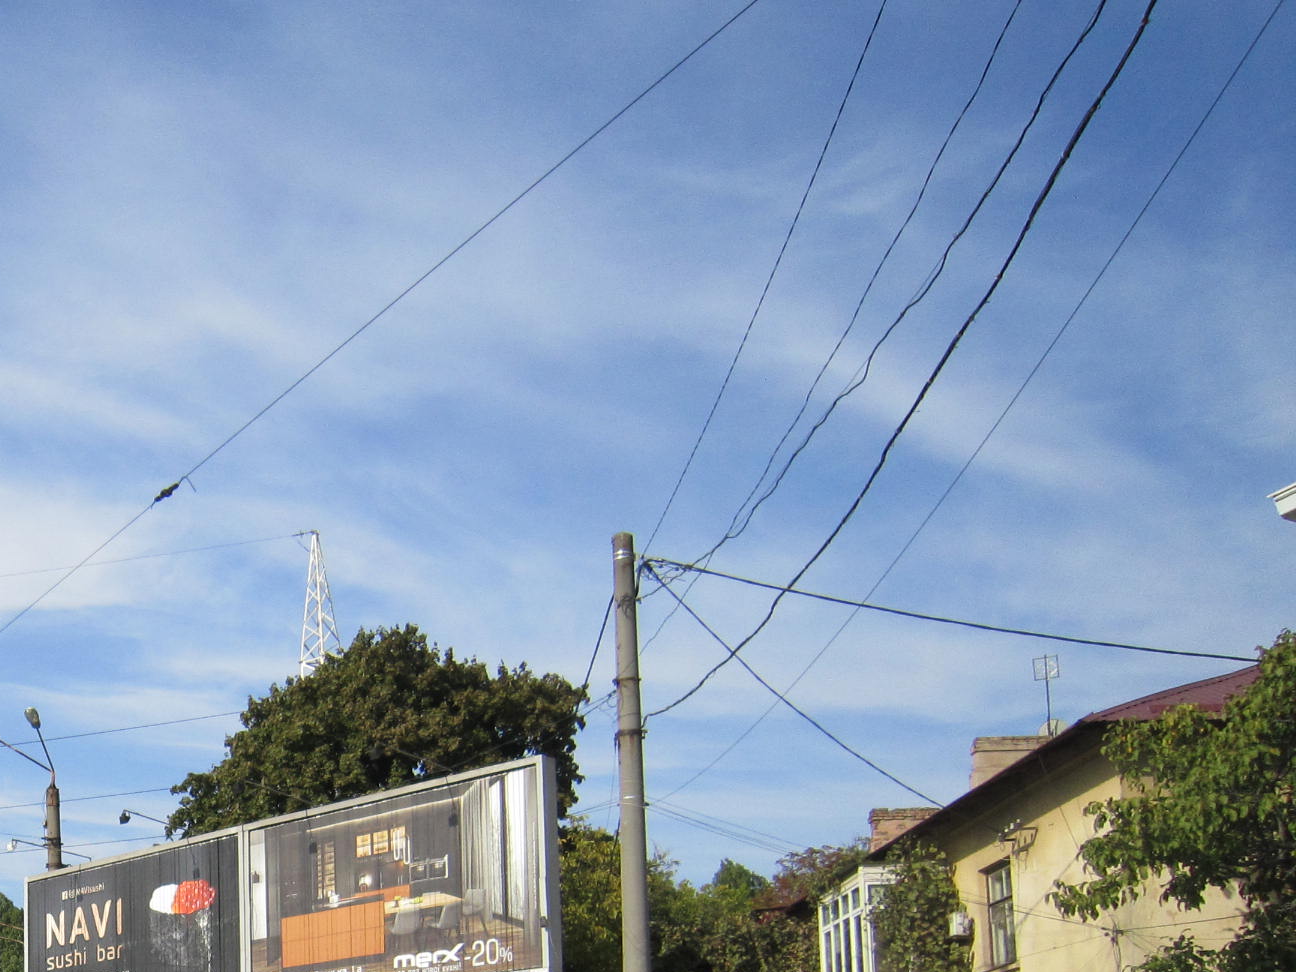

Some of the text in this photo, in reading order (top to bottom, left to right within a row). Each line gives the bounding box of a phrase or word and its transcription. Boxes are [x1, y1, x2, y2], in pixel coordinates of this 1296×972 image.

[46, 897, 122, 949] NAVI
[47, 943, 123, 971] sushi bar
[464, 938, 513, 967] -20%
